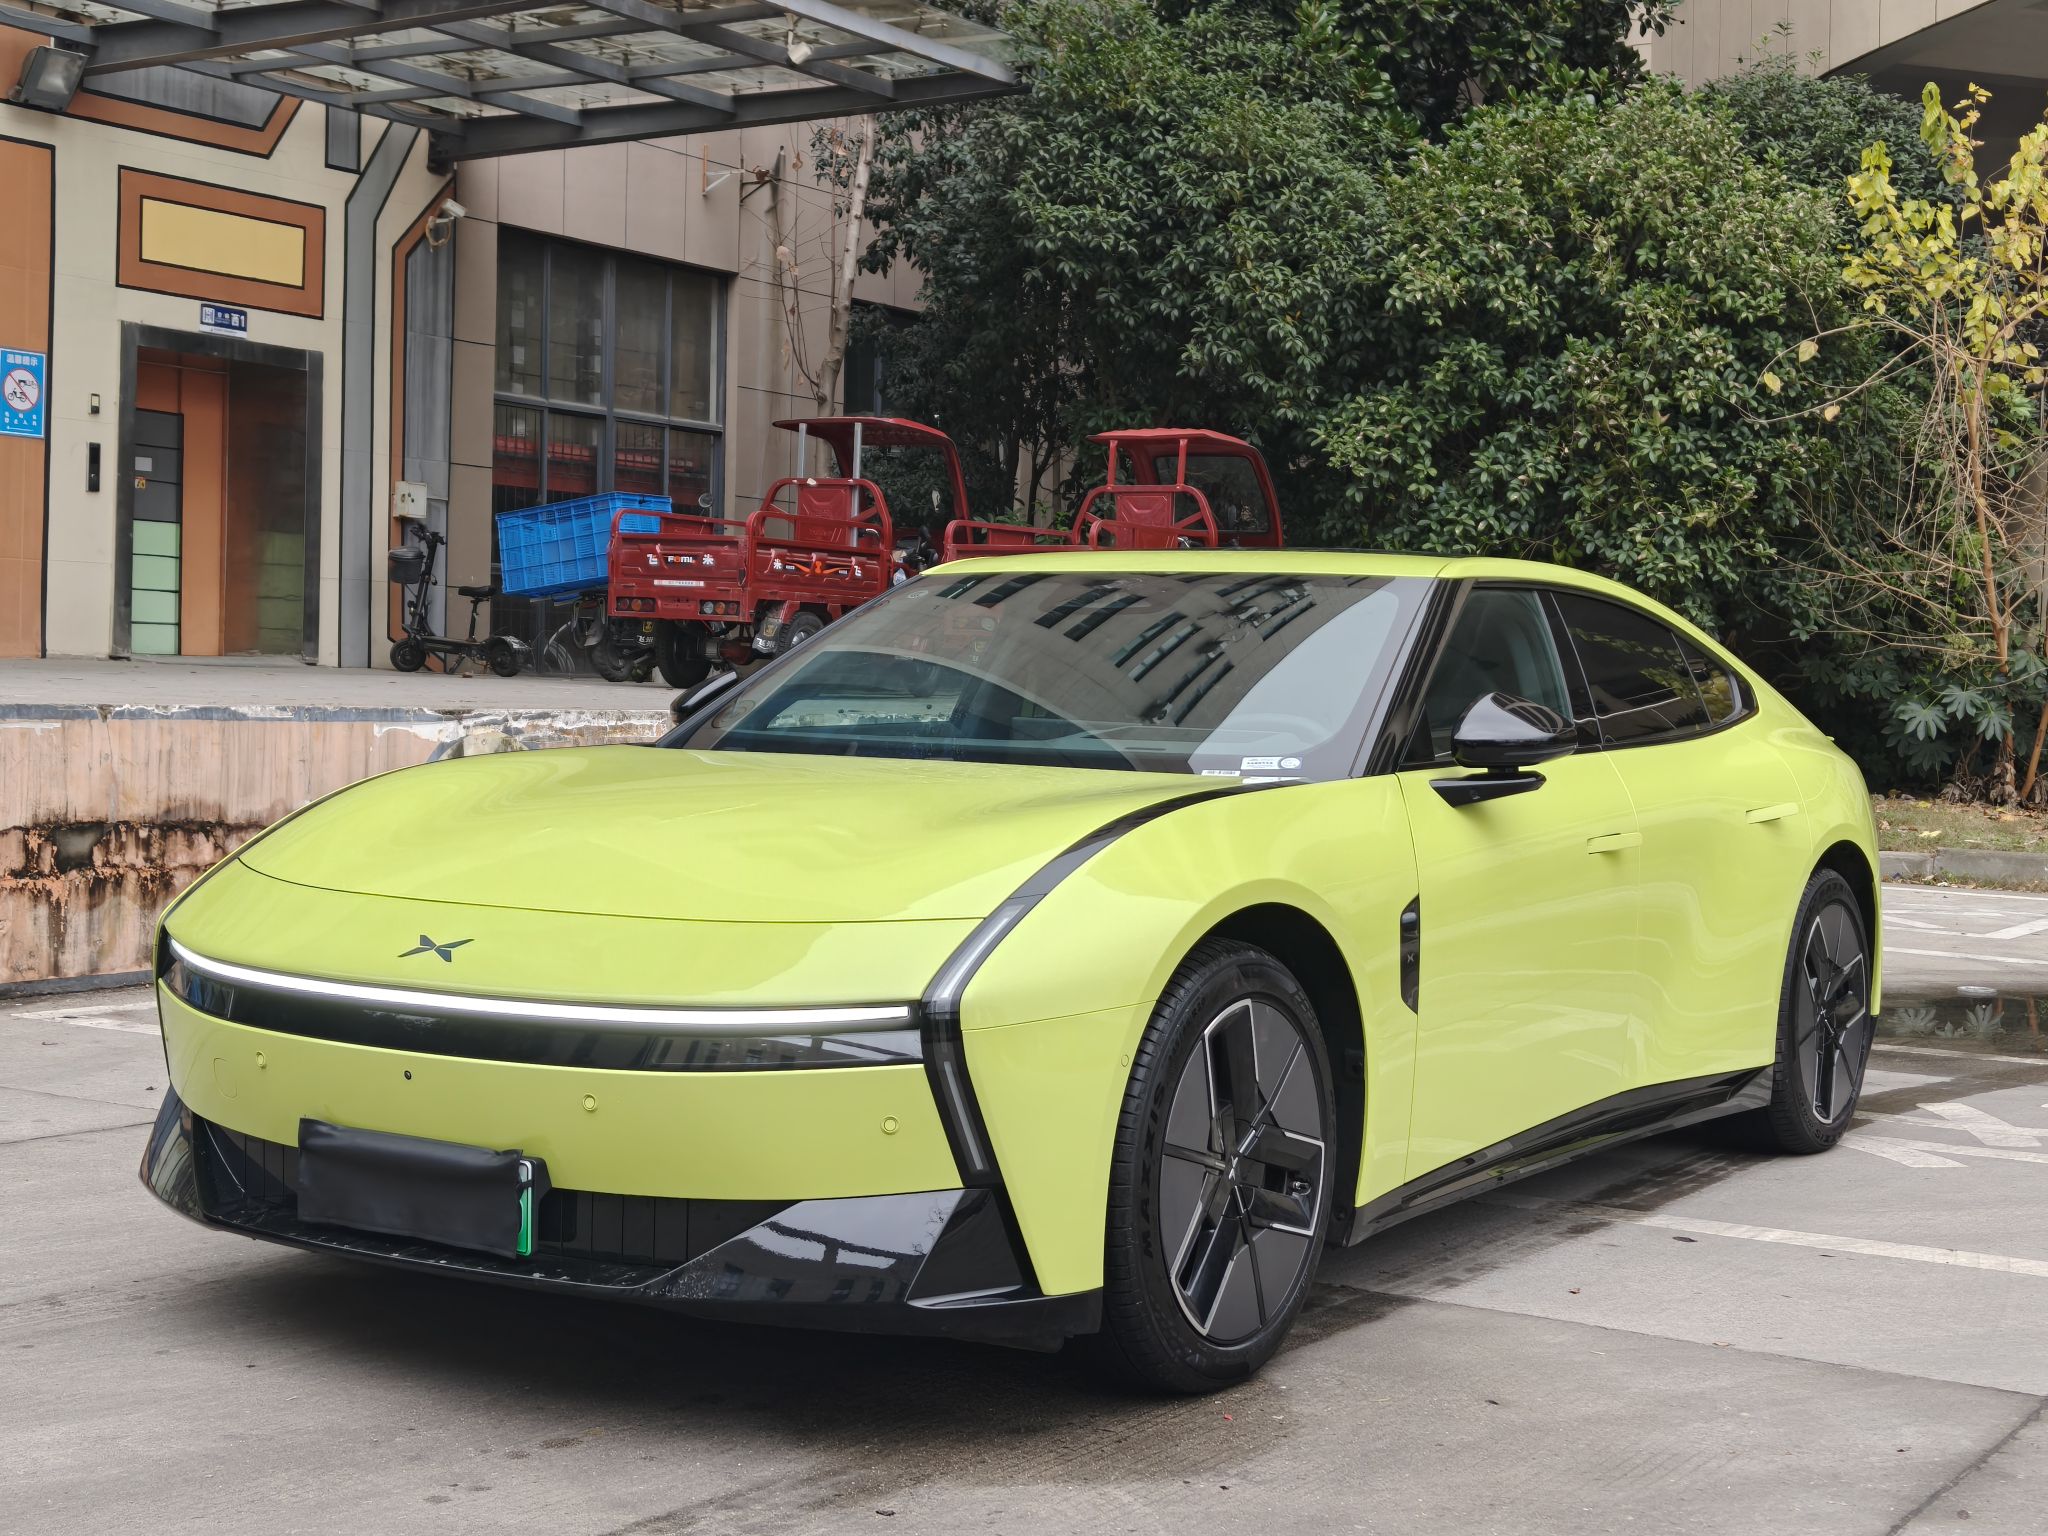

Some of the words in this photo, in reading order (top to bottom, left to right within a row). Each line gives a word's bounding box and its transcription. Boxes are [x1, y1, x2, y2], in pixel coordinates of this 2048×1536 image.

[702, 553, 714, 565] 米
[773, 558, 782, 570] 米
[1140, 1081, 1166, 1259] MAXXIS
